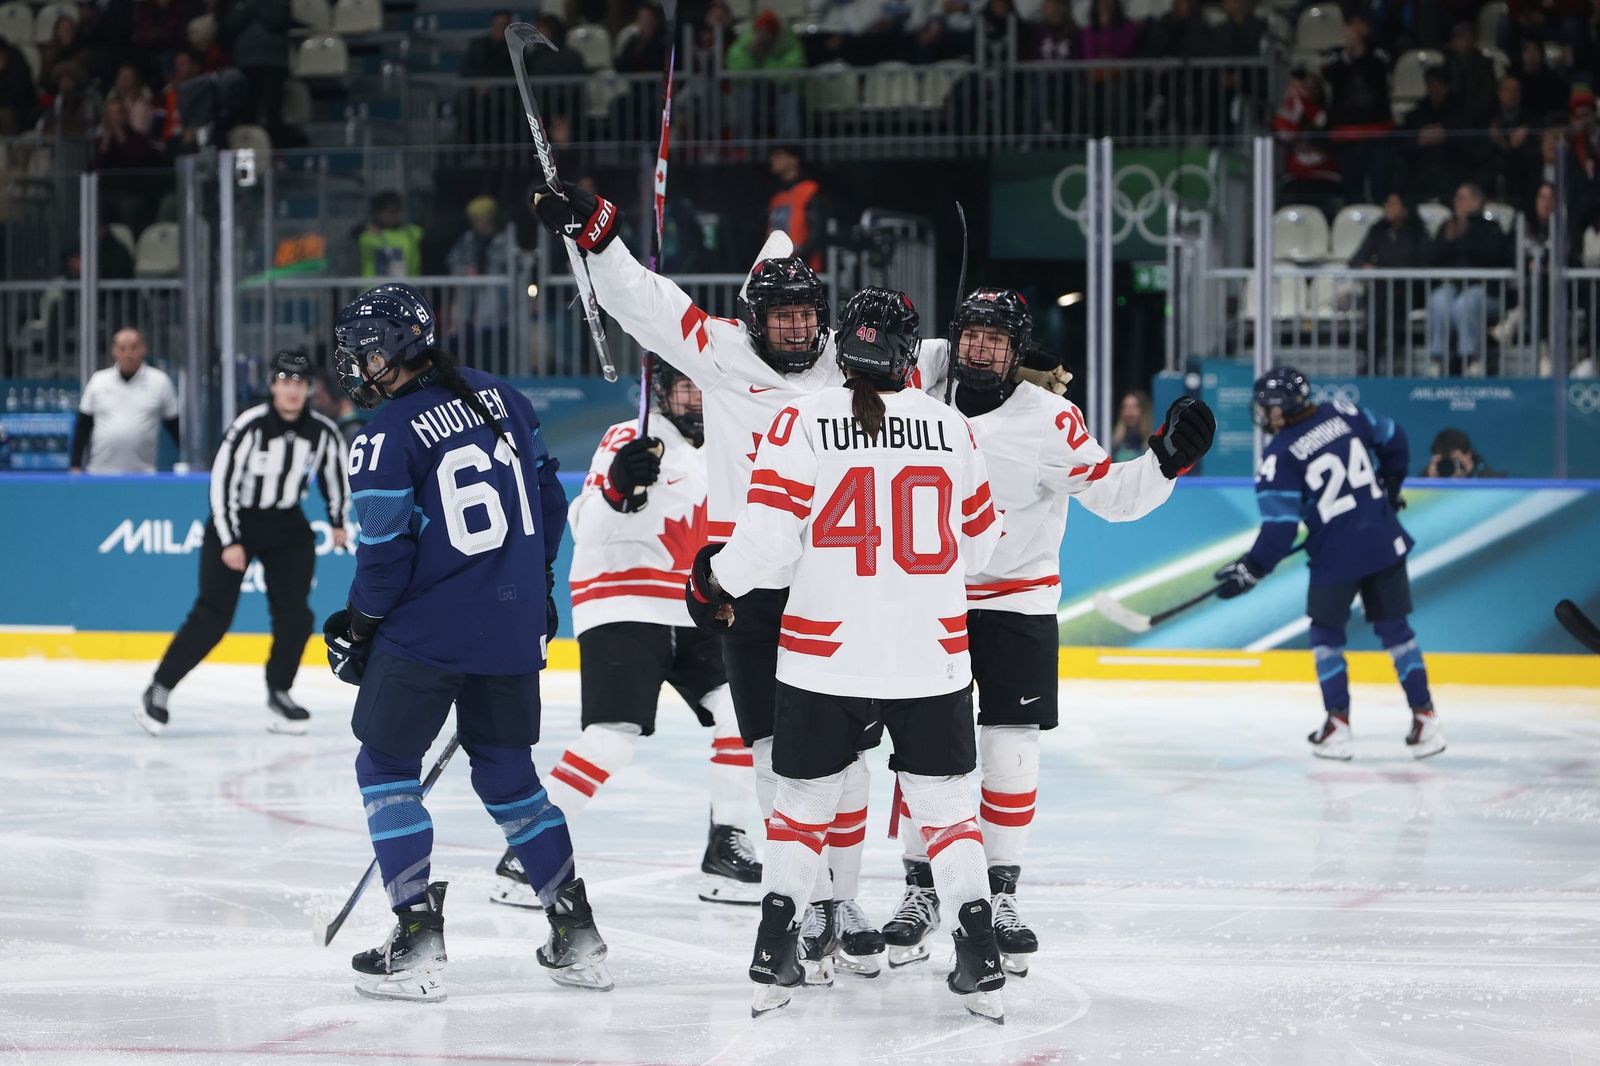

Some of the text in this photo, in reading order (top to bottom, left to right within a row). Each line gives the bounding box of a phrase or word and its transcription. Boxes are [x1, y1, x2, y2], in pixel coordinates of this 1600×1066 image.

[588, 199, 613, 242] UER
[360, 336, 379, 346] CCM
[856, 326, 877, 343] 40
[767, 406, 800, 447] 0
[348, 432, 386, 476] 61
[1255, 453, 1277, 483] 4
[436, 431, 535, 557] 61
[1305, 437, 1383, 524] 24
[98, 519, 206, 554] MILA
[812, 465, 959, 576] 40
